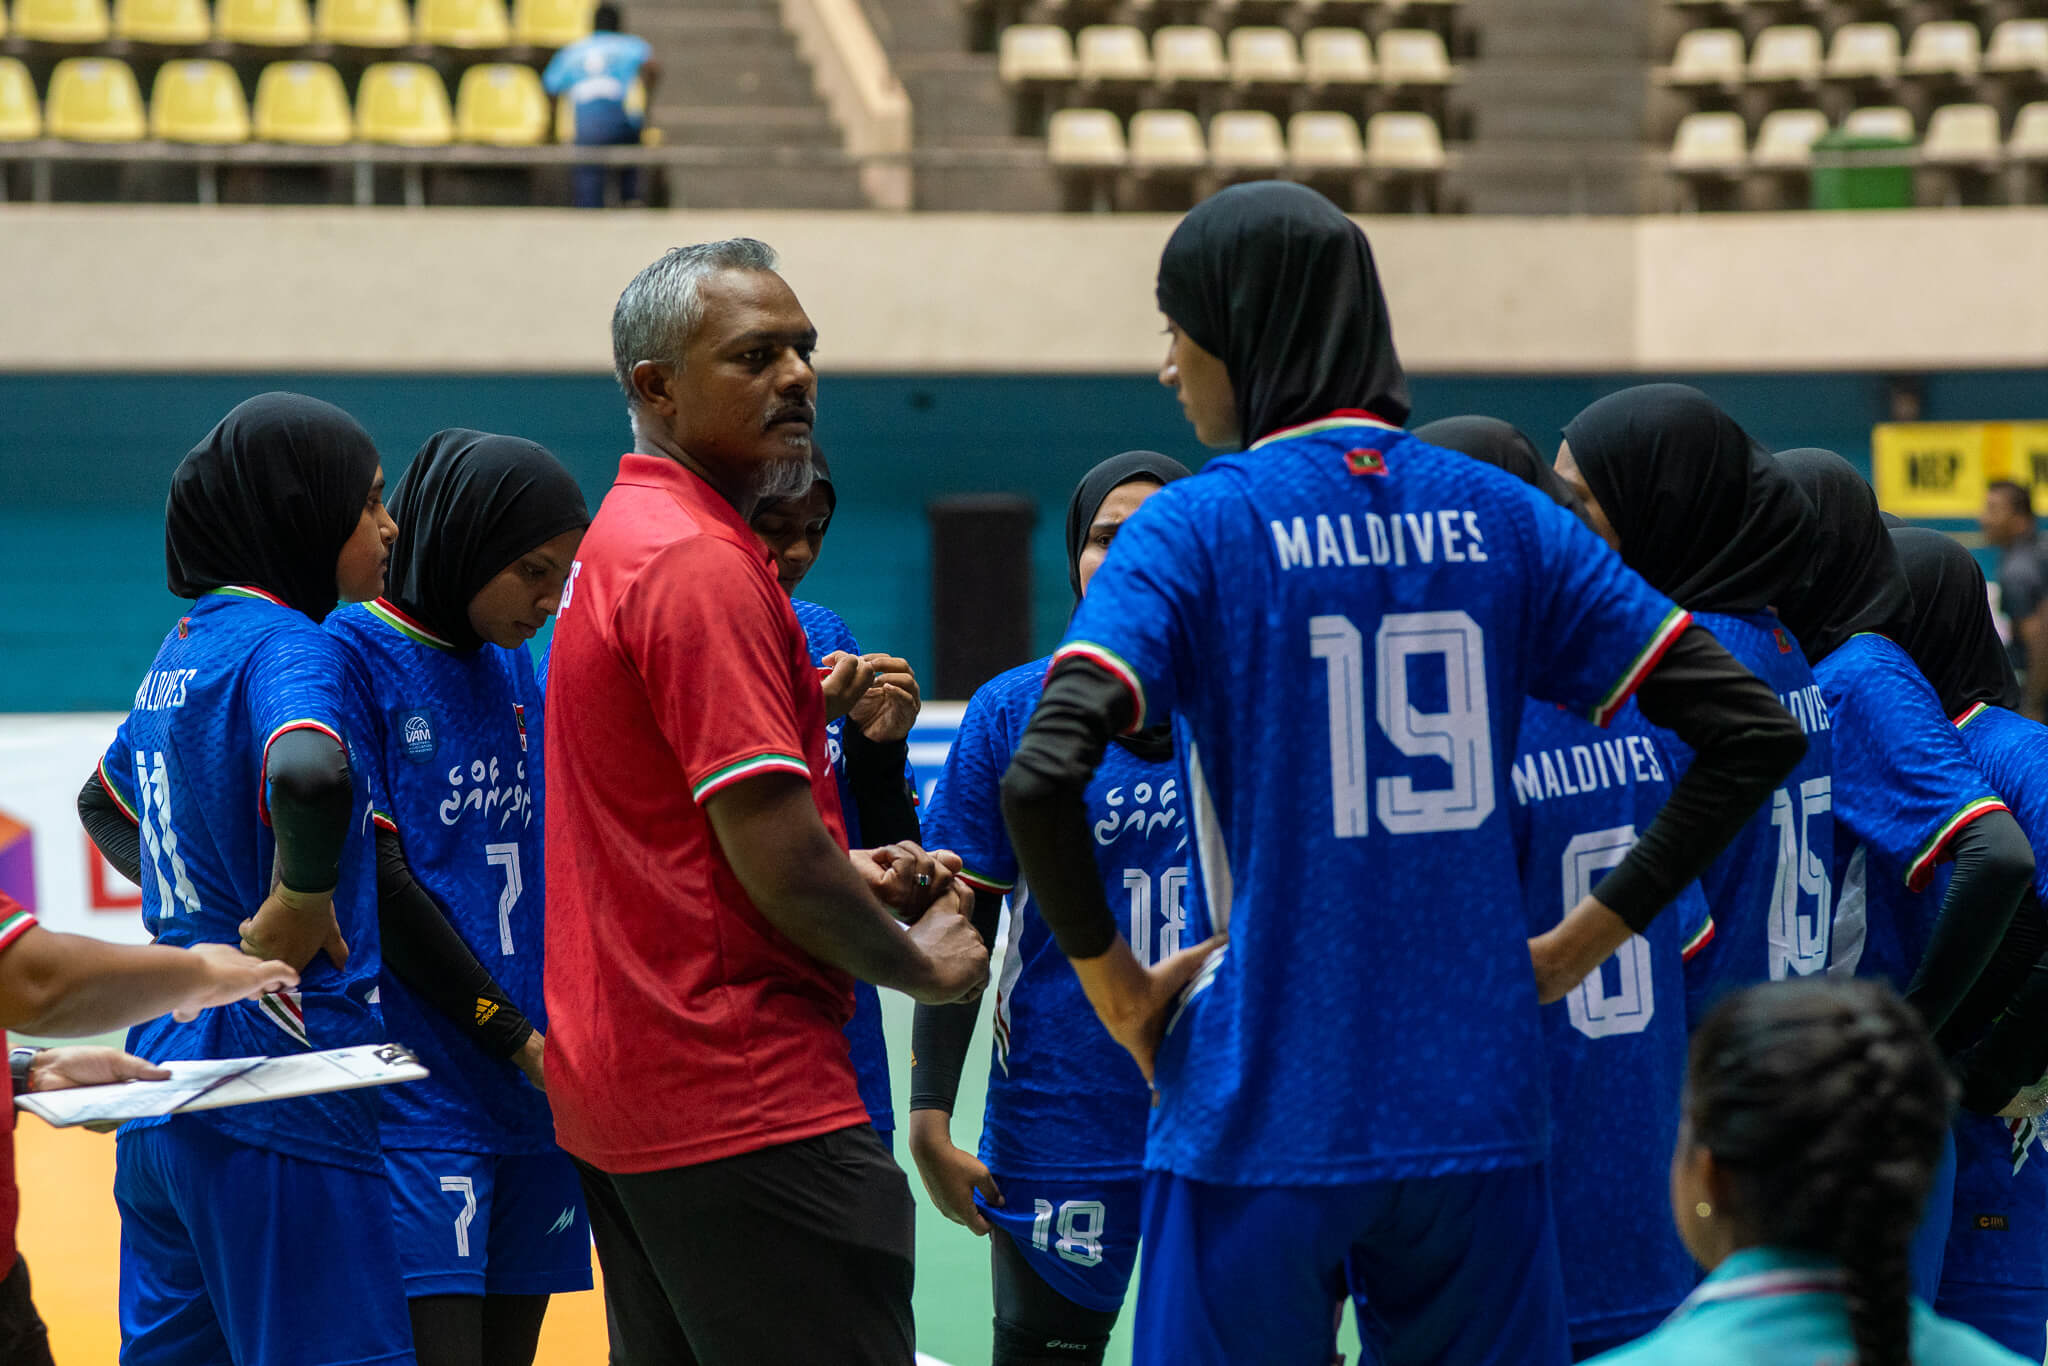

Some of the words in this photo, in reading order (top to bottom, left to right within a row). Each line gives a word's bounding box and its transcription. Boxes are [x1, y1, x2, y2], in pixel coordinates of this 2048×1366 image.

[1271, 509, 1488, 571] MALDIVES
[405, 729, 431, 743] VAM
[1308, 610, 1496, 838] 19
[1511, 735, 1665, 806] MALDIVES
[135, 750, 202, 920] 11
[485, 842, 523, 956] 7
[1123, 866, 1189, 970] 18
[1767, 774, 1833, 983] 15
[477, 1003, 500, 1026] adidas
[439, 1176, 477, 1257] 7
[1032, 1198, 1106, 1268] 18
